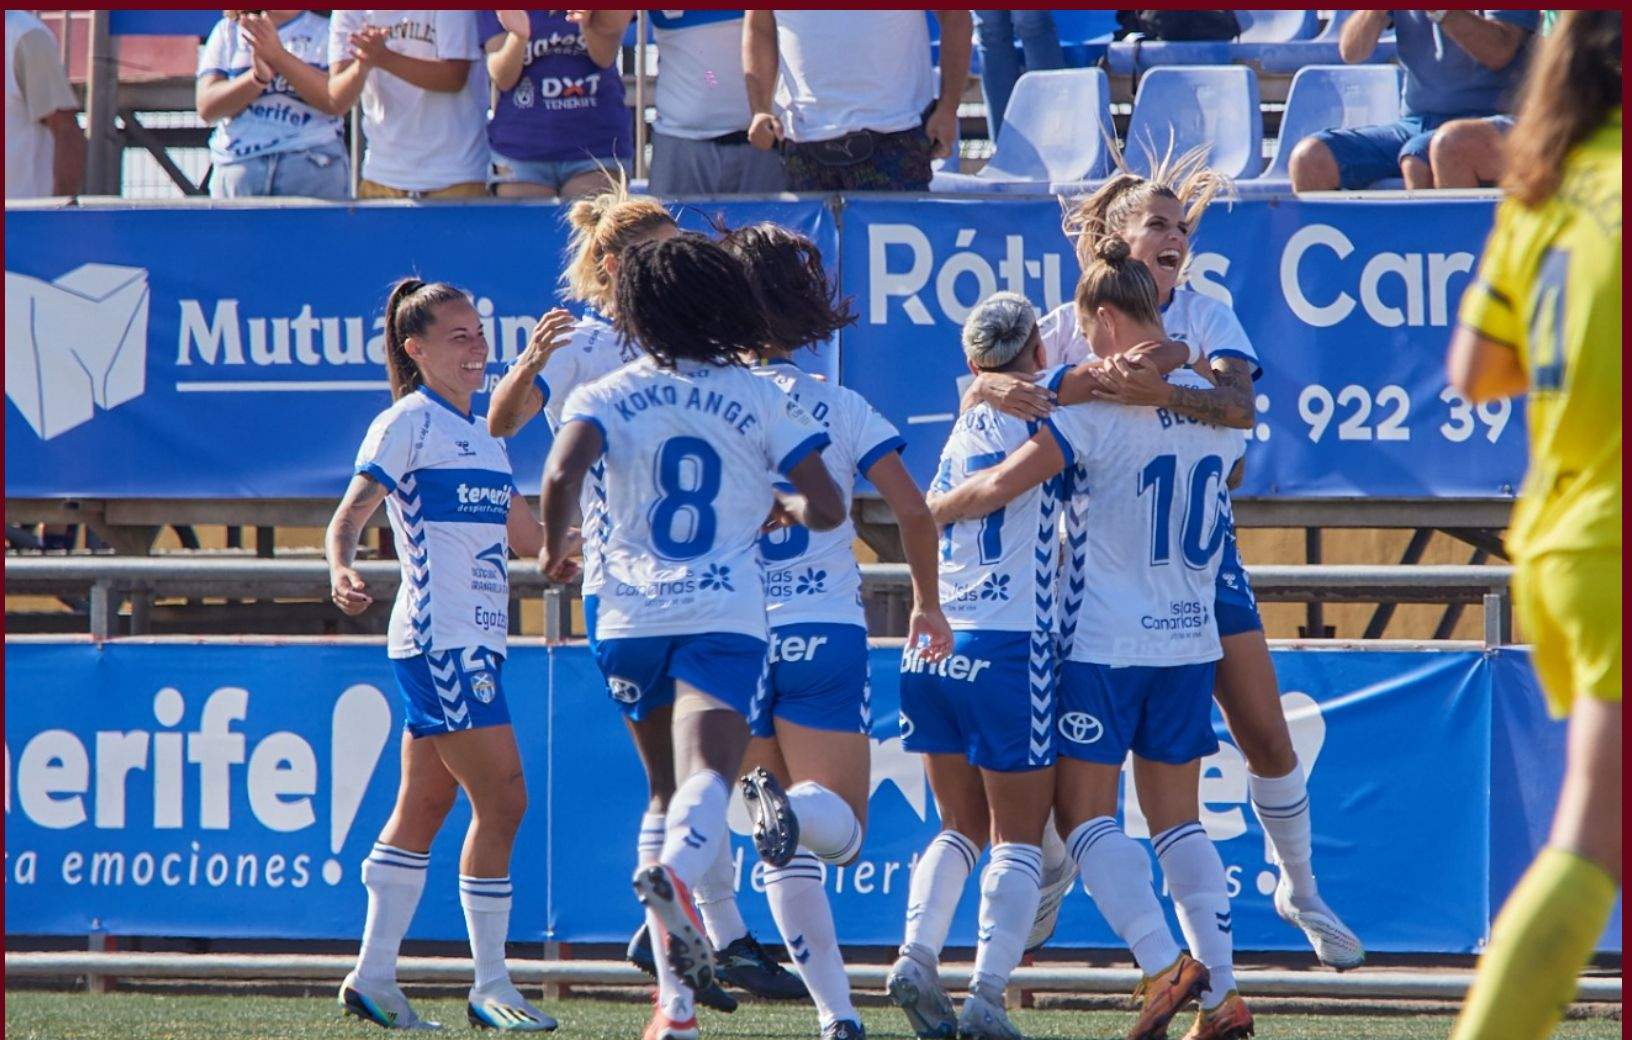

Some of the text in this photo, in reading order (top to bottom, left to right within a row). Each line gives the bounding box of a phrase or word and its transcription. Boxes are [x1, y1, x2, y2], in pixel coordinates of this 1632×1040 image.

[868, 223, 1232, 325] Rótus
[1280, 223, 1478, 327] Car
[614, 384, 757, 436] KOKO ANGE
[1299, 384, 1411, 443] 922
[1440, 385, 1512, 444] 39
[647, 436, 722, 561] 8
[1137, 454, 1225, 571] 10
[769, 633, 829, 664] ter
[5, 684, 391, 886] erife!
[62, 841, 312, 889] emociones
